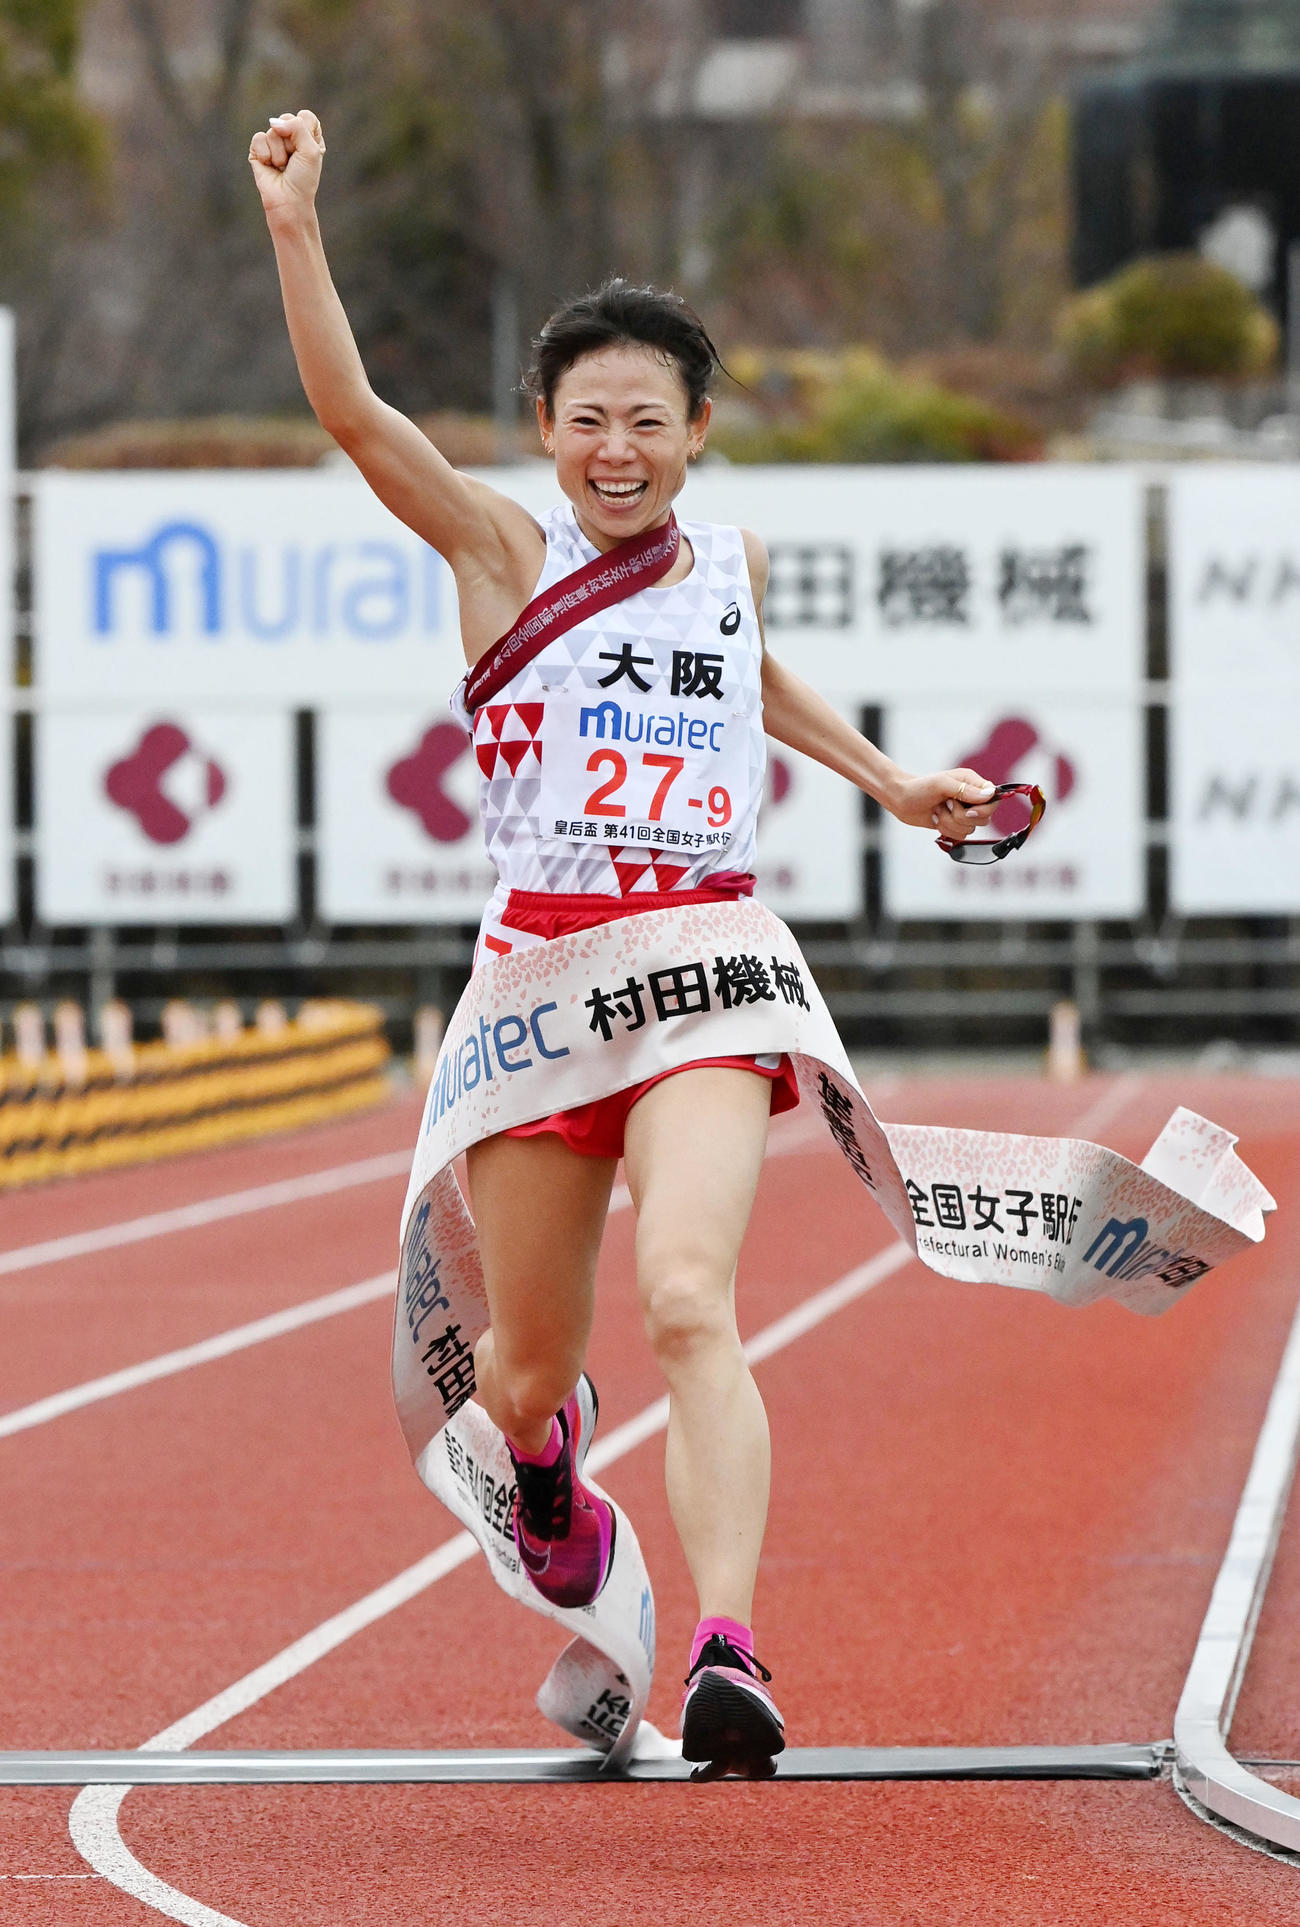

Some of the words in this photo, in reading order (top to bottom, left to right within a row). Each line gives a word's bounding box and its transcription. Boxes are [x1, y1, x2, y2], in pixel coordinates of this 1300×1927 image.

[762, 540, 1094, 628] 田機械
[597, 643, 725, 700] 大阪
[579, 701, 724, 752] muratec
[554, 820, 598, 838] 皇后盃
[584, 953, 811, 1041] 村田機械
[427, 1001, 570, 1136] muratec
[993, 1243, 1052, 1267] Women's
